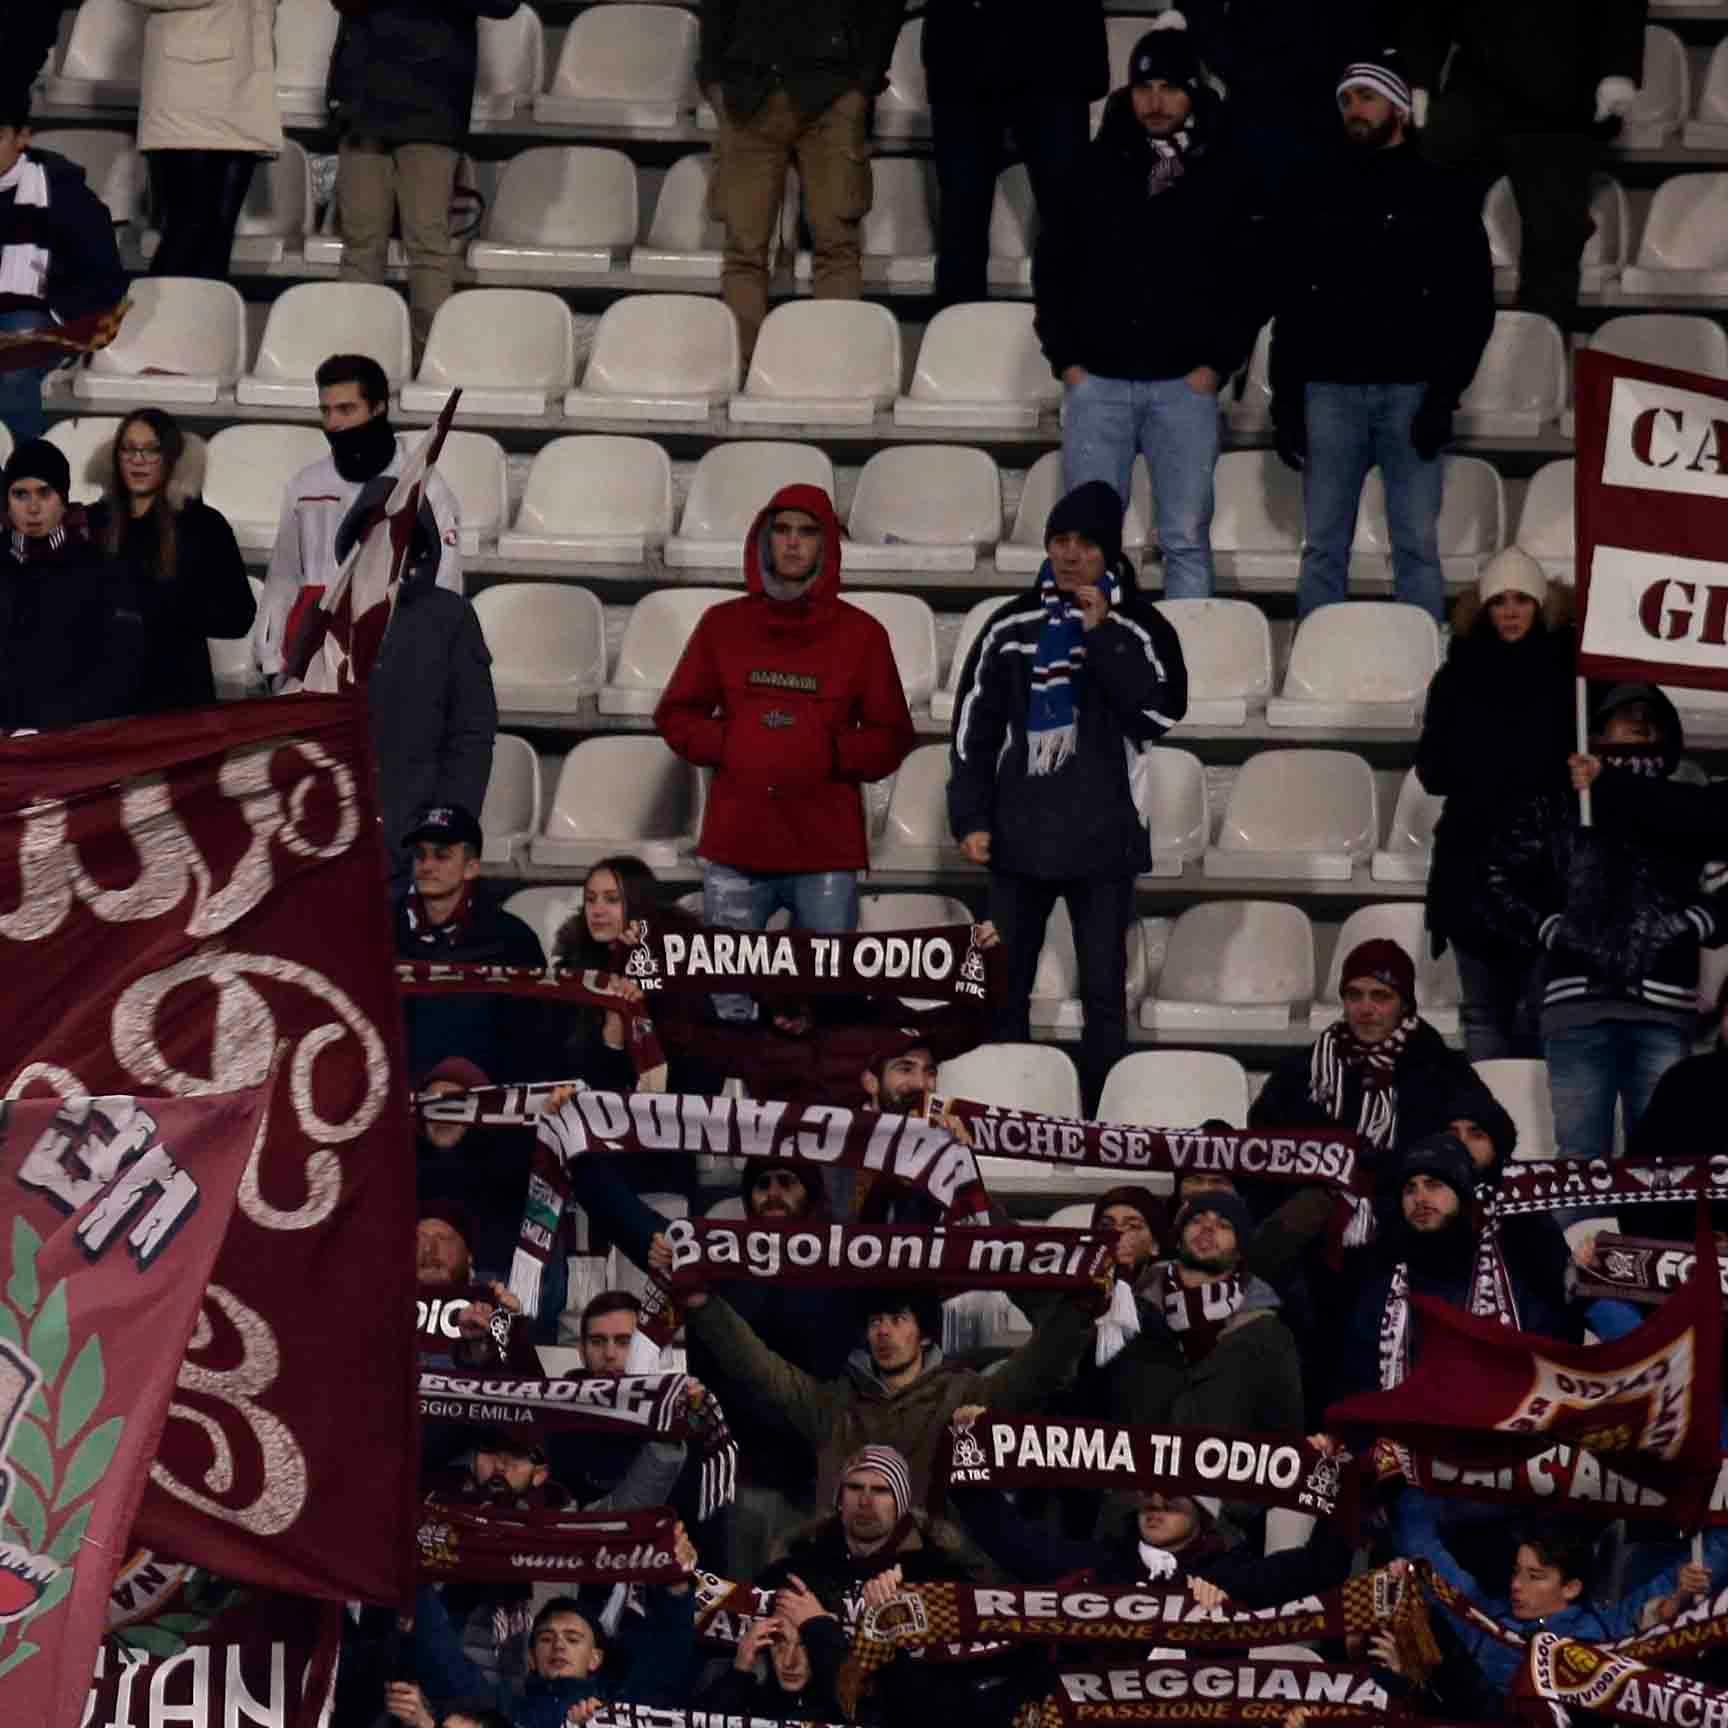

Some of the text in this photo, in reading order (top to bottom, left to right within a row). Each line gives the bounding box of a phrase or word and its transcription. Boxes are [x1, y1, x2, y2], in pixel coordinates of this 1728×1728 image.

[663, 932, 799, 977] PARMA
[810, 935, 840, 977] TI
[852, 936, 953, 981] ODIO
[973, 1108, 1088, 1160] NCHE
[1098, 1127, 1153, 1167] SE
[468, 1403, 536, 1424] EMILIA
[991, 1424, 1302, 1490] PARMA TI ODIO
[980, 1617, 1156, 1640] PASSIONE
[1060, 1664, 1389, 1710] REGGIANA
[1076, 1698, 1232, 1720] PASSIONE
